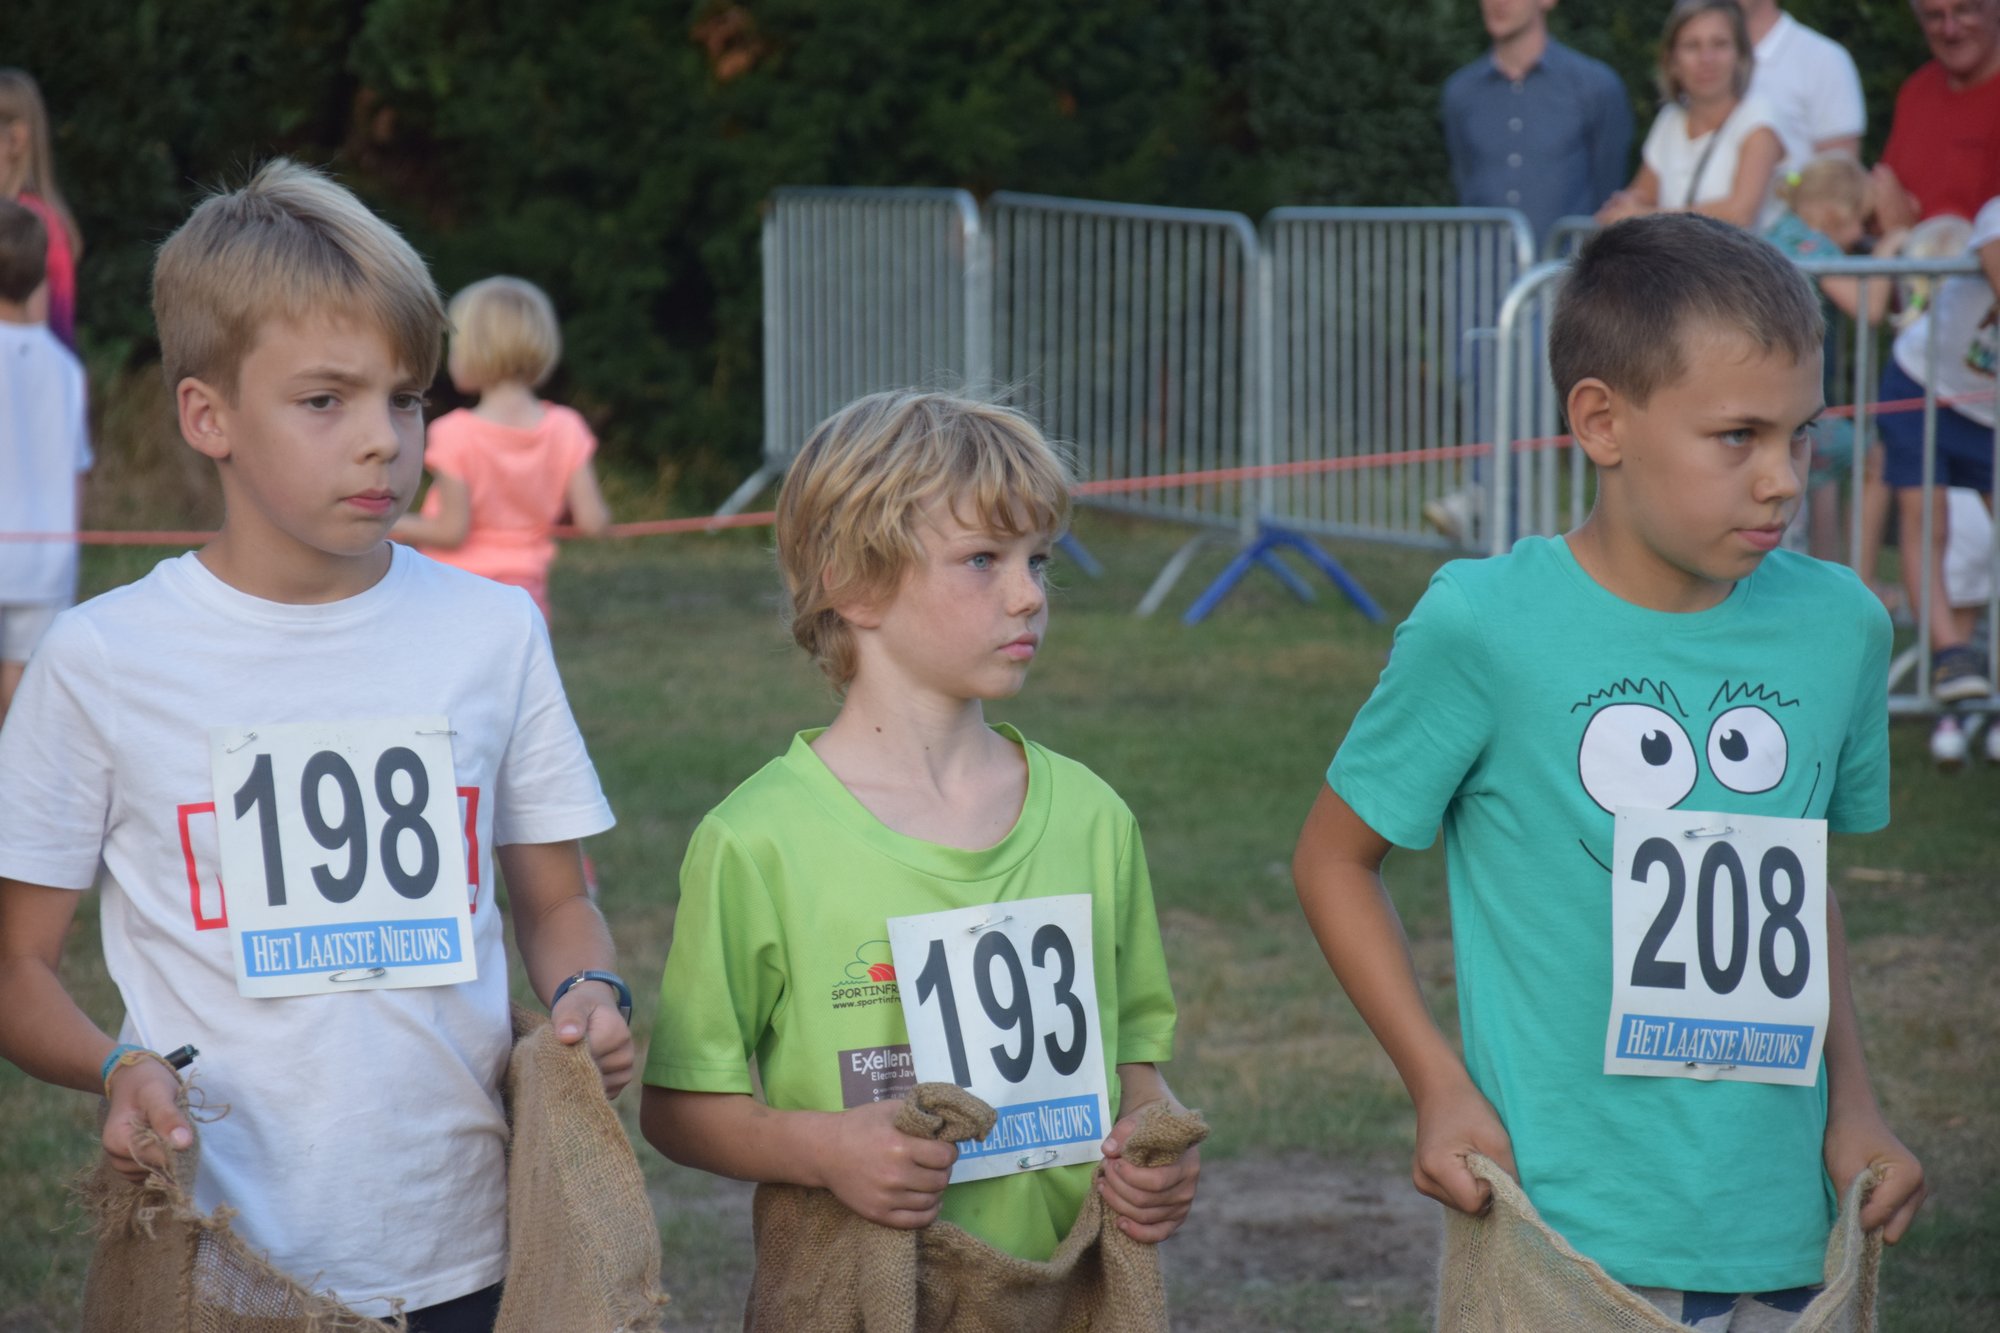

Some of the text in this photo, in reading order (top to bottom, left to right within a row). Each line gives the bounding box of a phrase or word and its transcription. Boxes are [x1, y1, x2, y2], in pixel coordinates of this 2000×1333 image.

[233, 746, 440, 907] 198
[1630, 837, 1811, 1000] 208
[251, 926, 451, 973] HET LAATSTE NIEUWS
[831, 984, 899, 1001] SPORTINFR
[832, 995, 901, 1009] www.sportinfr
[915, 924, 1088, 1088] 193
[1625, 1019, 1804, 1066] HET LAATSTE NIEUWS
[871, 1071, 897, 1081] Electro
[1038, 1105, 1093, 1141] NIEUWS
